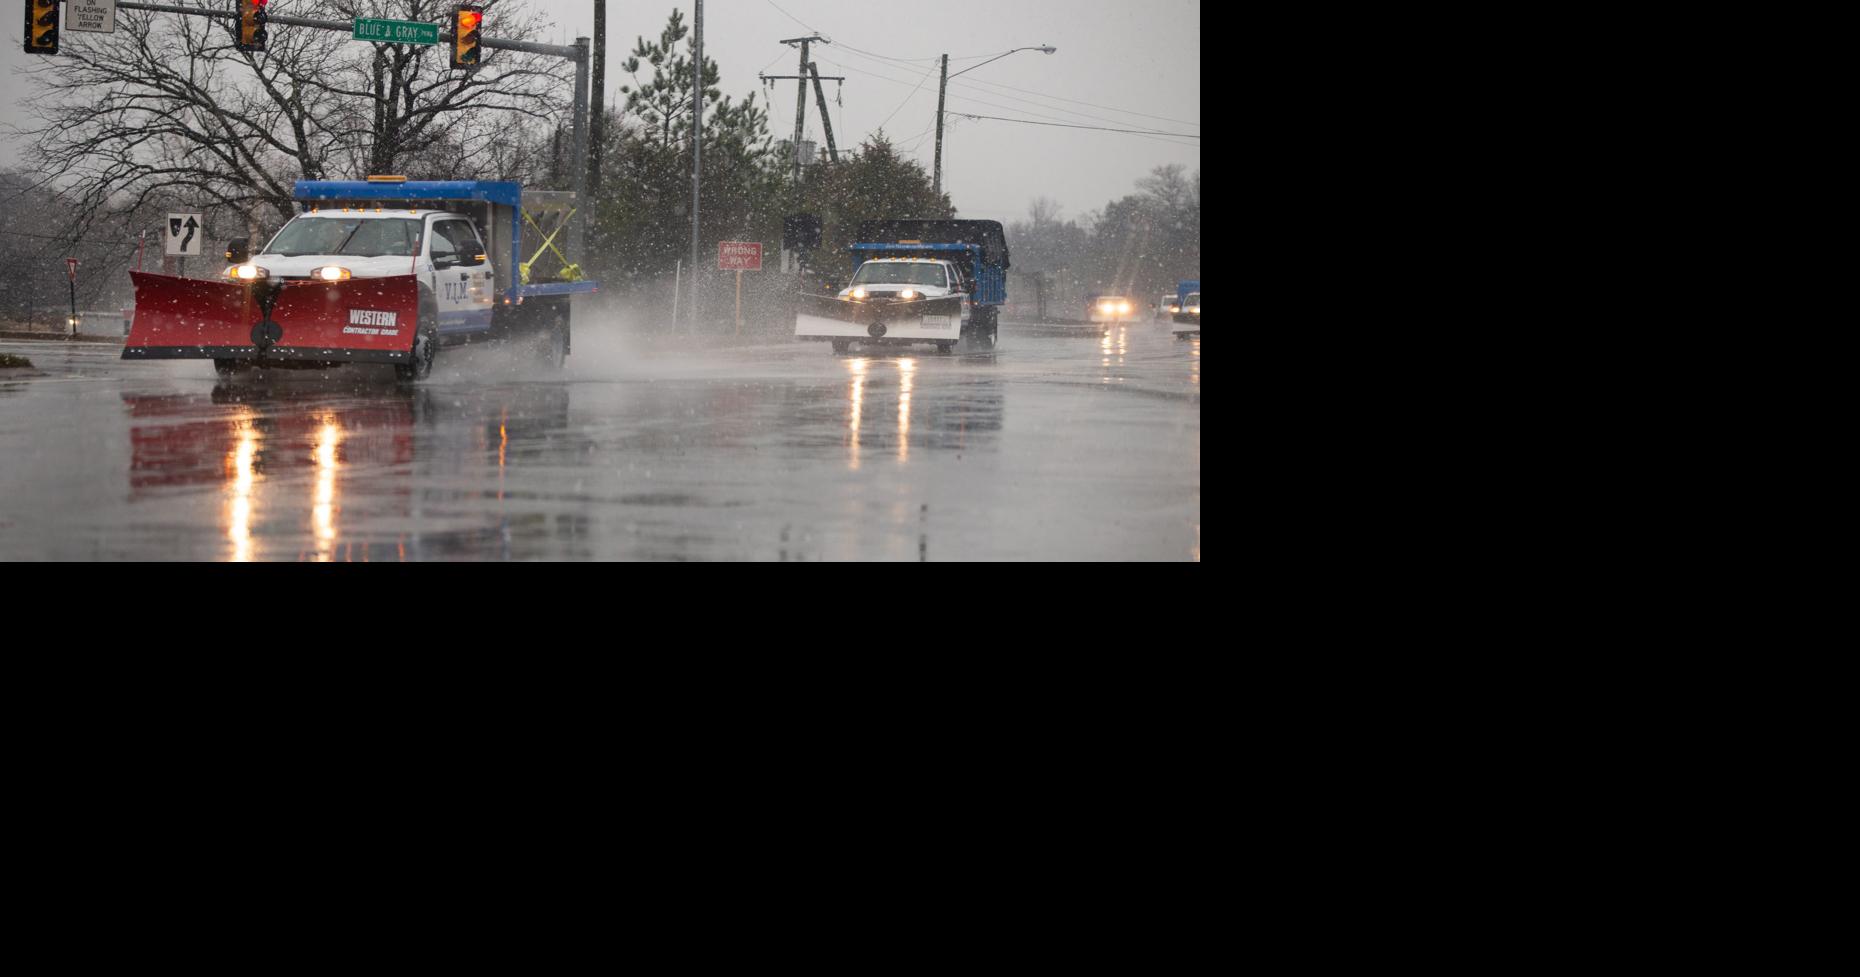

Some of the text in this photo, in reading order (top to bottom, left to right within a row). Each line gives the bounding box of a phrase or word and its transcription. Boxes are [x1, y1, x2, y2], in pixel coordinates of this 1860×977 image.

[74, 5, 108, 15] FLASHING
[77, 12, 105, 21] YELLOW
[78, 21, 102, 29] ARROW
[359, 23, 381, 36] BLUE
[384, 25, 391, 37] &
[395, 25, 418, 39] GRAY
[723, 246, 757, 256] WRONG
[730, 256, 752, 267] WAY
[350, 309, 397, 327] WESTERN
[343, 325, 380, 335] CONTRACTOR
